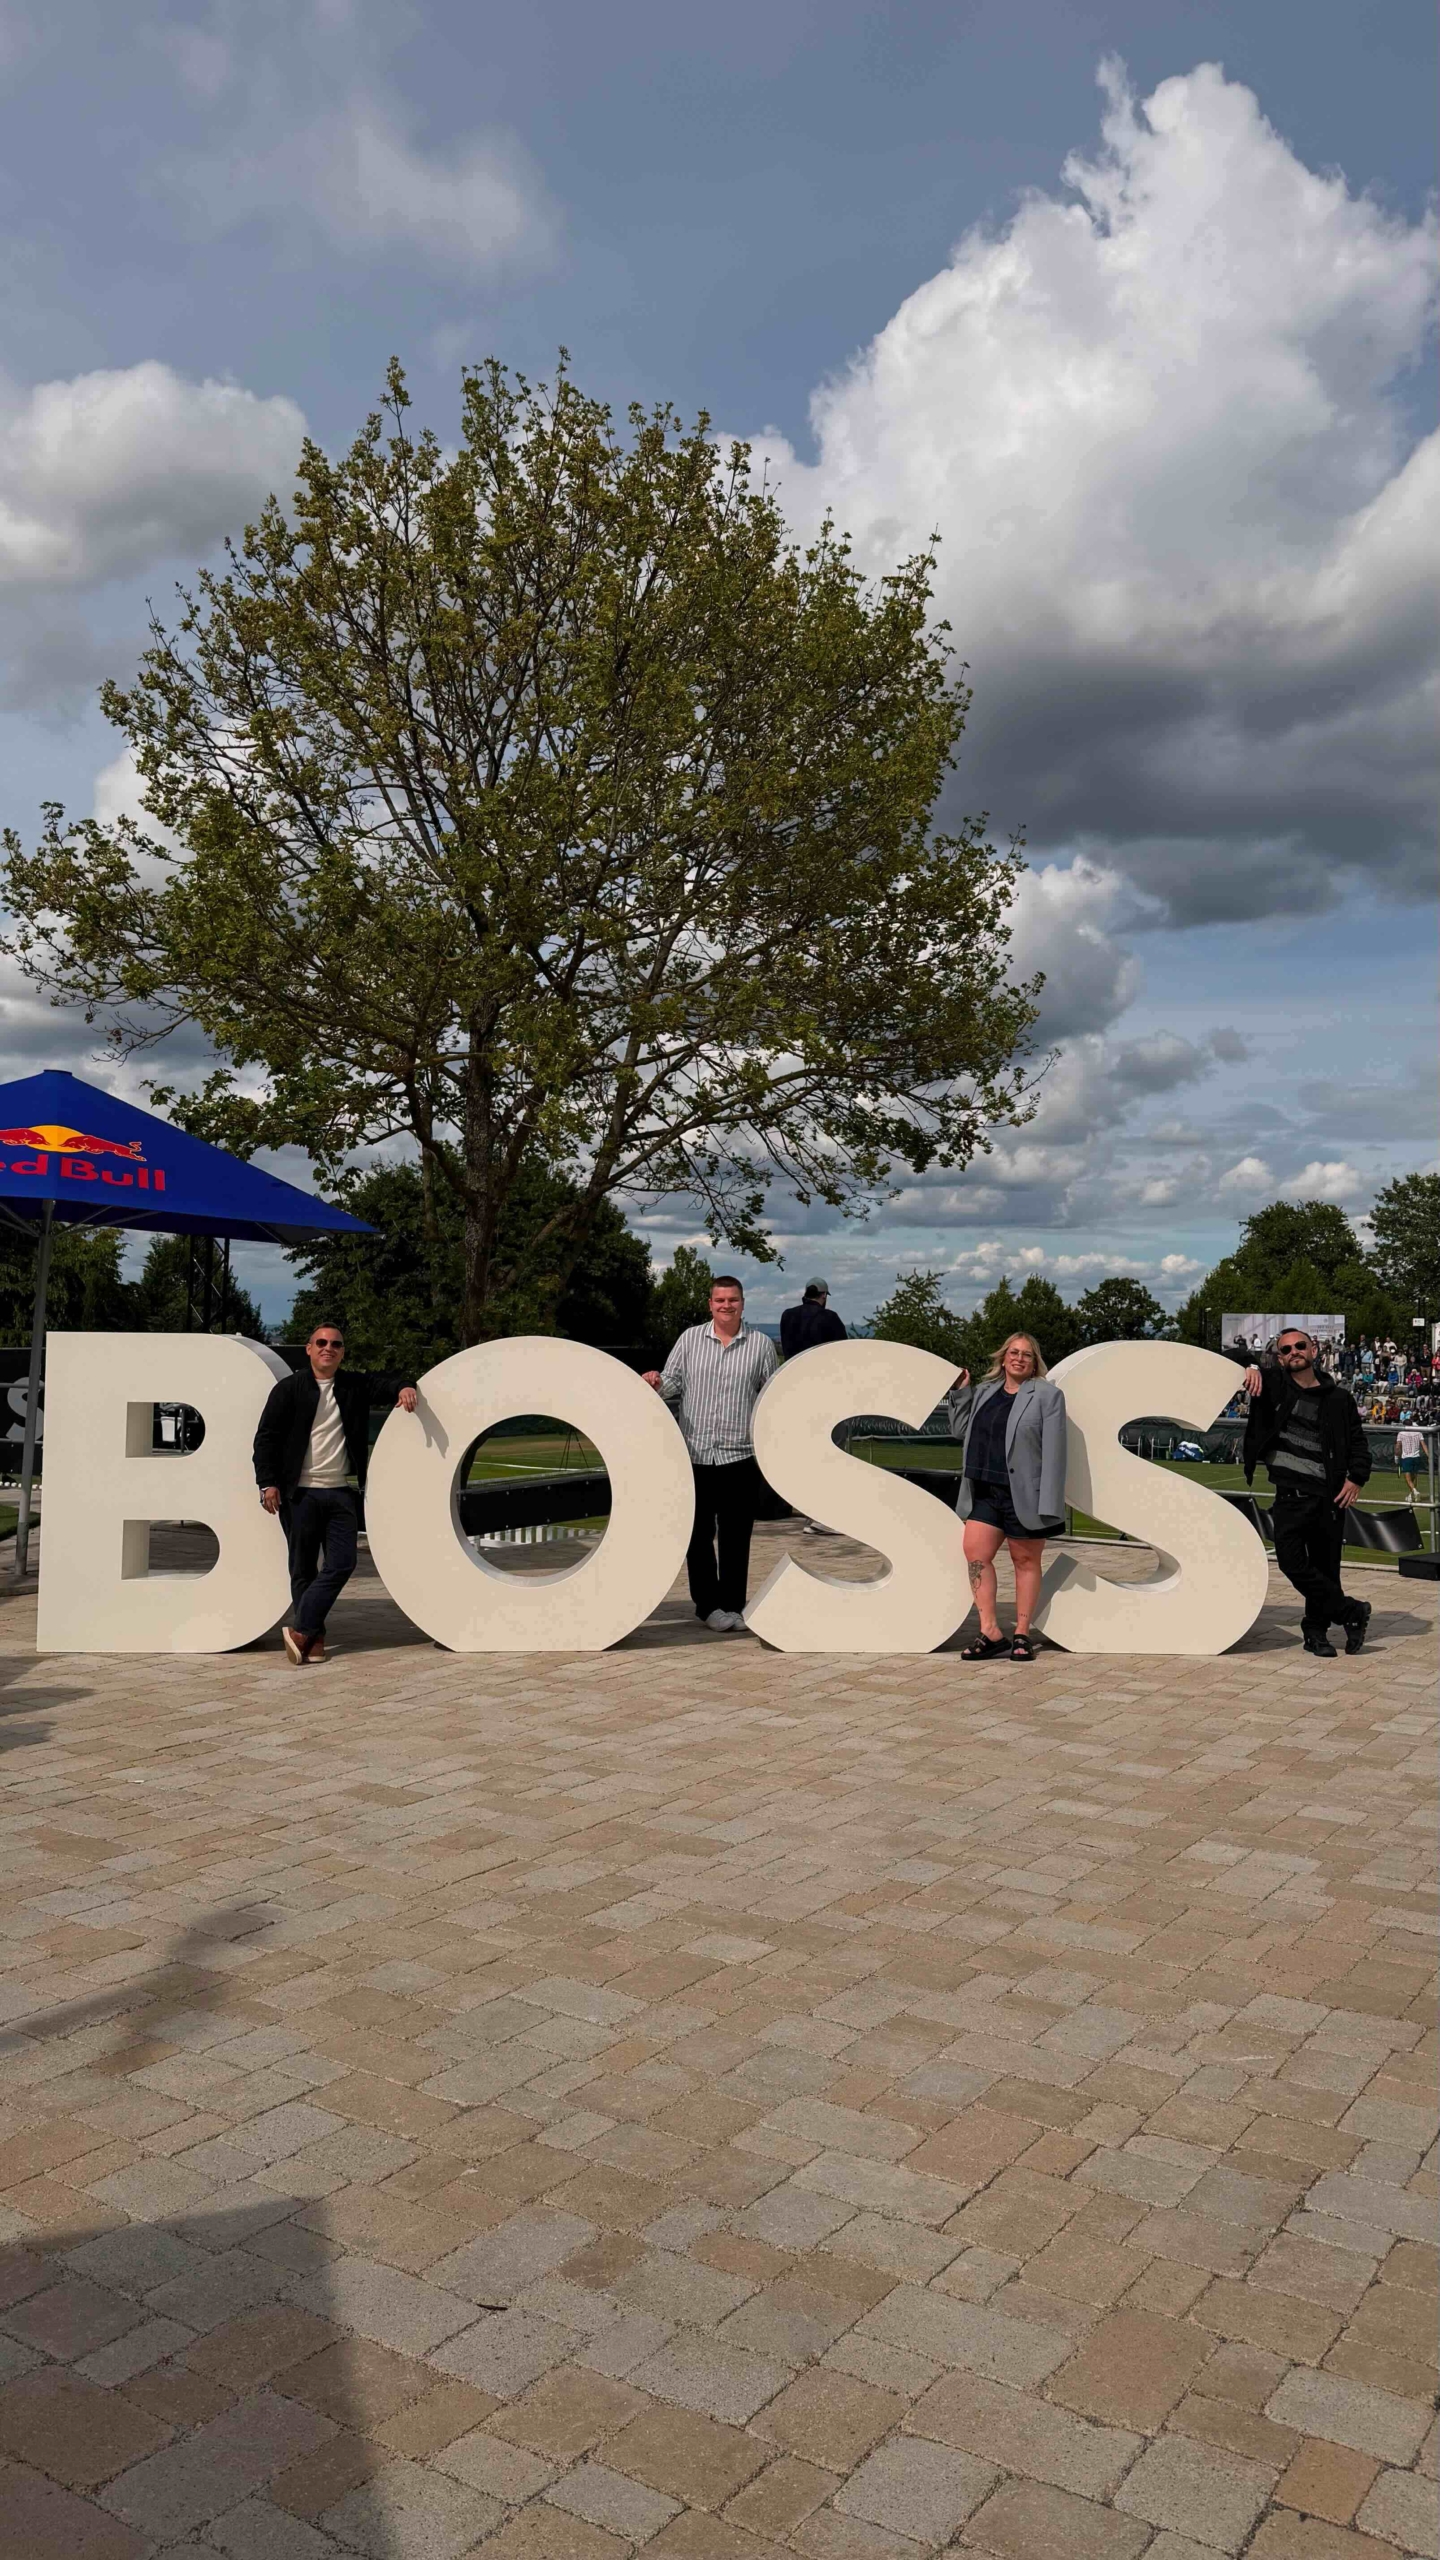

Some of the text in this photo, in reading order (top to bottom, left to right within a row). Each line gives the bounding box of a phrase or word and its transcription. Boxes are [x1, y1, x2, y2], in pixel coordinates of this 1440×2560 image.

[0, 1154, 166, 1191] d Bull
[37, 1331, 1269, 1655] BOSS
